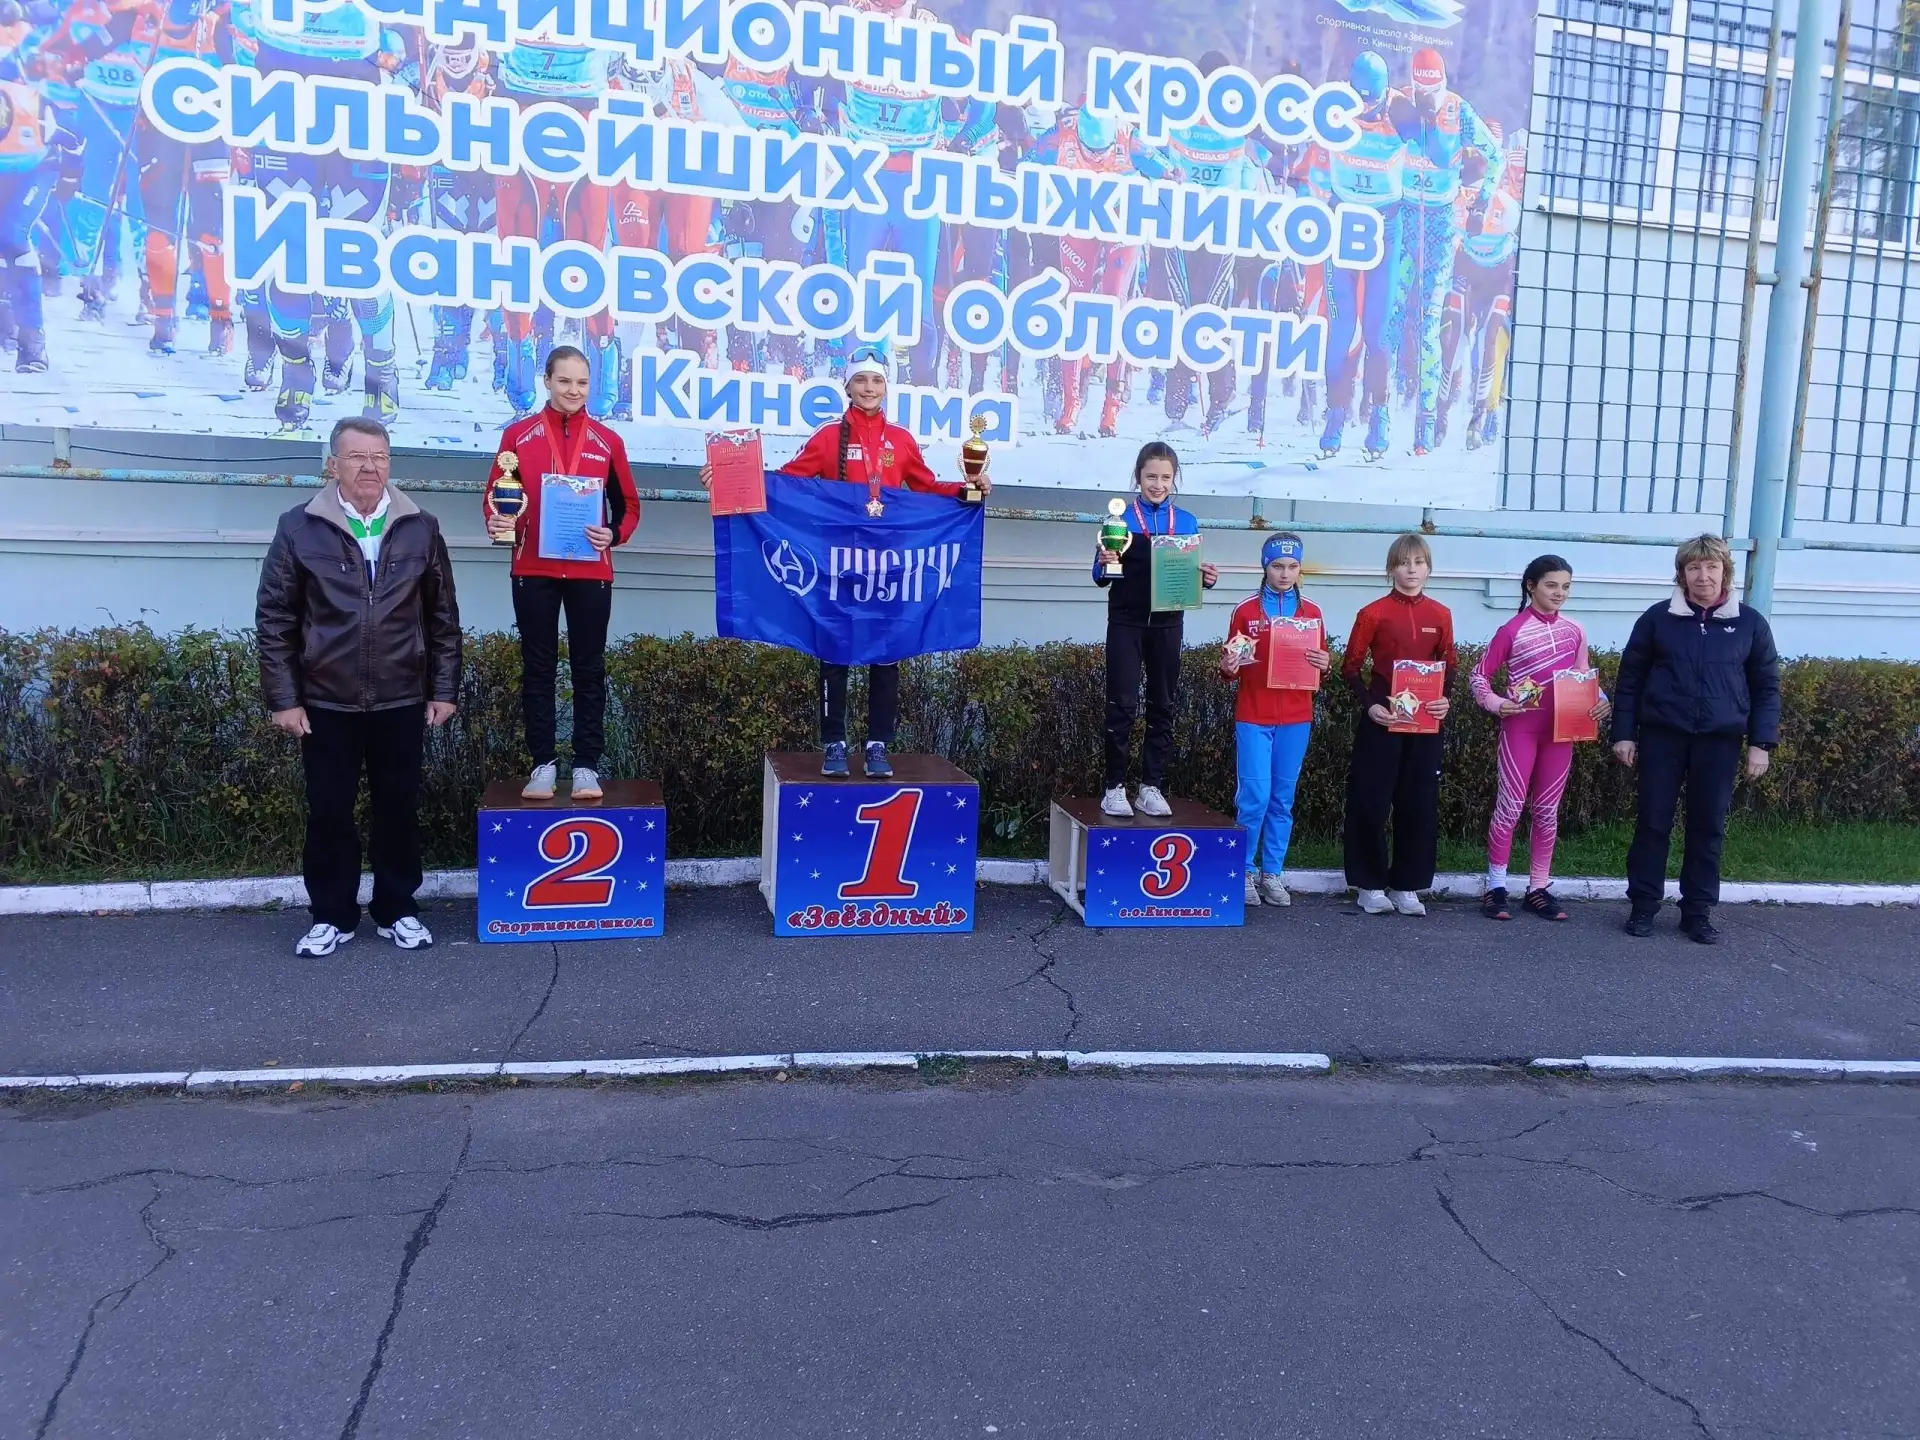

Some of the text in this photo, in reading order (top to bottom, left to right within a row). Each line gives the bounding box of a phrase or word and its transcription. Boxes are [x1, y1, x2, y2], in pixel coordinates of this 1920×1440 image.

[1315, 14, 1371, 33] Спортивная
[1372, 27, 1402, 39] школа
[1371, 37, 1413, 53] Кинешма
[268, 0, 1360, 143] диционный кросс
[540, 51, 556, 71] 7
[96, 65, 137, 83] 108
[878, 101, 900, 124] 17
[150, 67, 1383, 265] сильнейших лыжников
[1190, 166, 1222, 182] 207
[1354, 173, 1373, 189] 11
[1413, 173, 1434, 188] 26
[1059, 240, 1087, 273] LUKOIL
[232, 194, 1324, 375] Ивановской области
[640, 354, 1013, 444] Кинема
[1271, 540, 1300, 549] LUKOIL
[836, 788, 924, 900] 1
[522, 816, 624, 909] 2
[1140, 832, 1196, 899] 3
[488, 916, 654, 936] Спортивная школа
[787, 902, 968, 930] «Звёздный»
